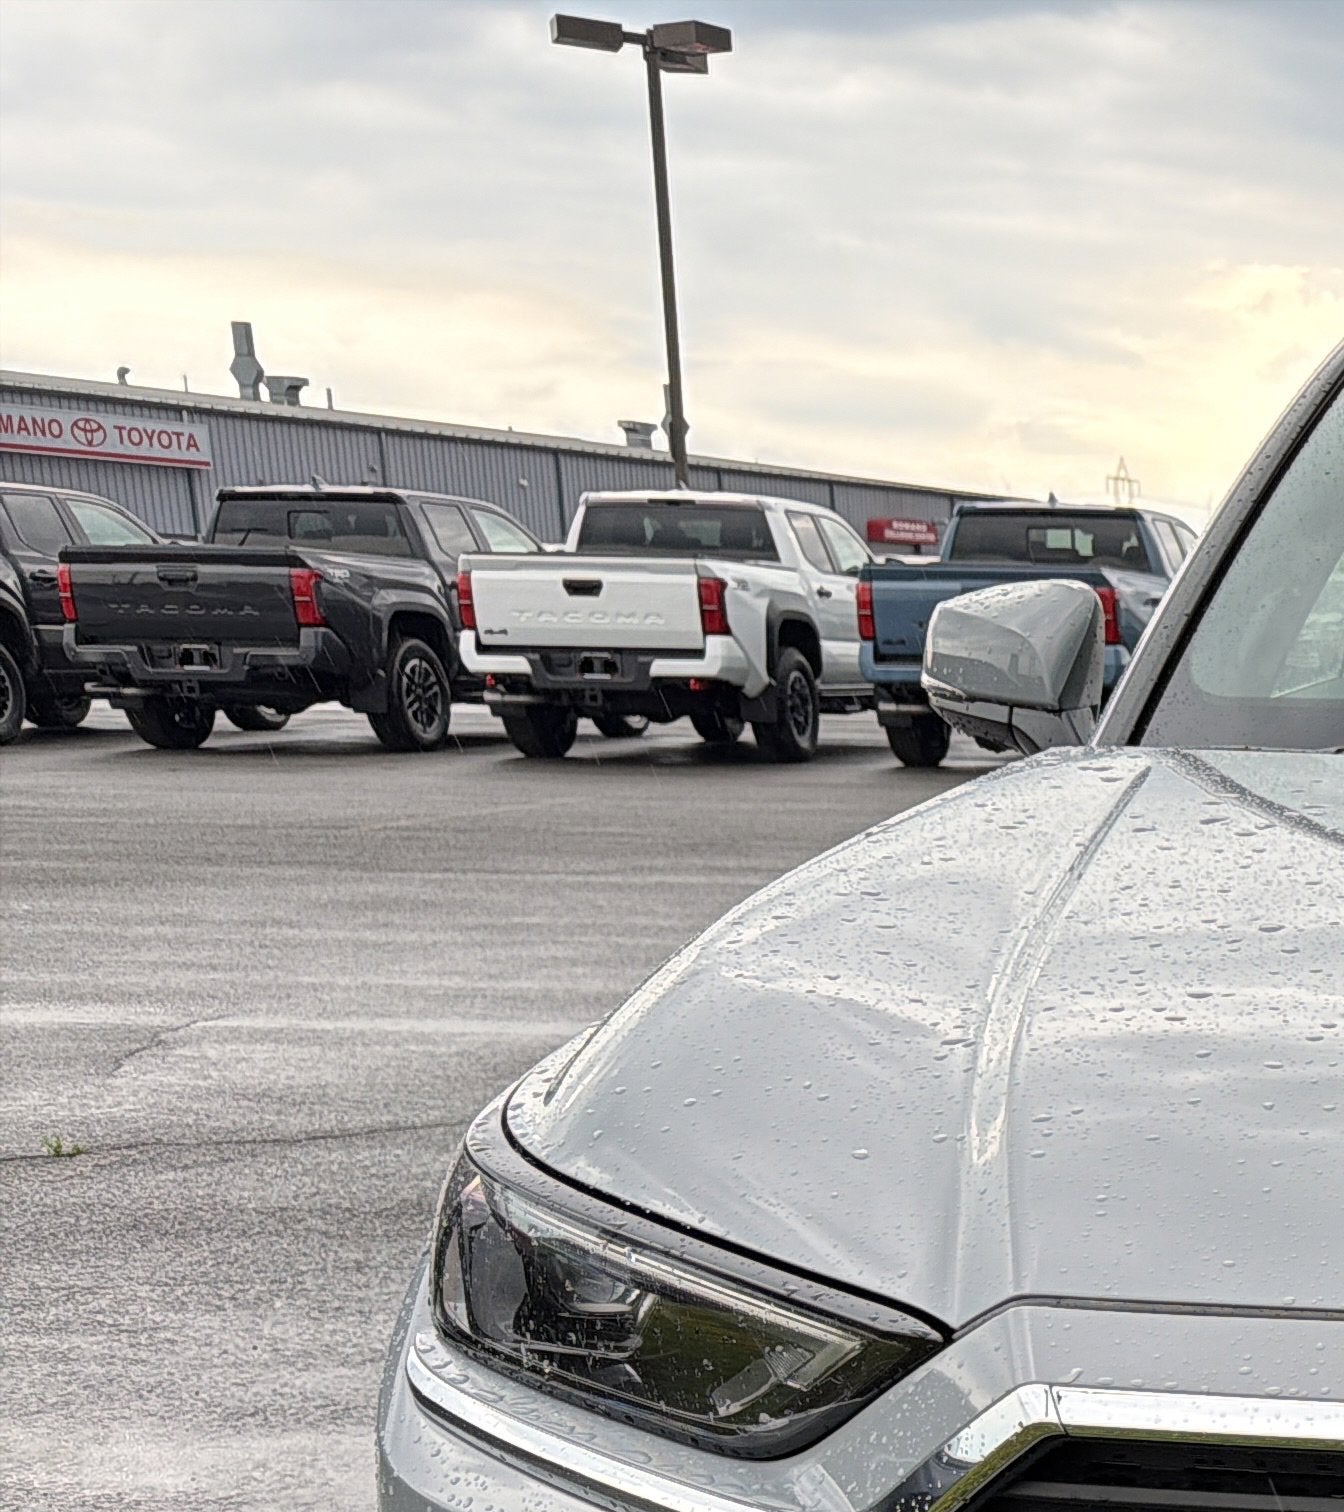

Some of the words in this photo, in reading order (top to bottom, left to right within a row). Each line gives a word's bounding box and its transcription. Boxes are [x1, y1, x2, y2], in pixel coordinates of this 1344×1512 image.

[113, 424, 200, 452] TOYOTA
[107, 603, 260, 616] TACOMA
[509, 610, 666, 626] TACOMA
